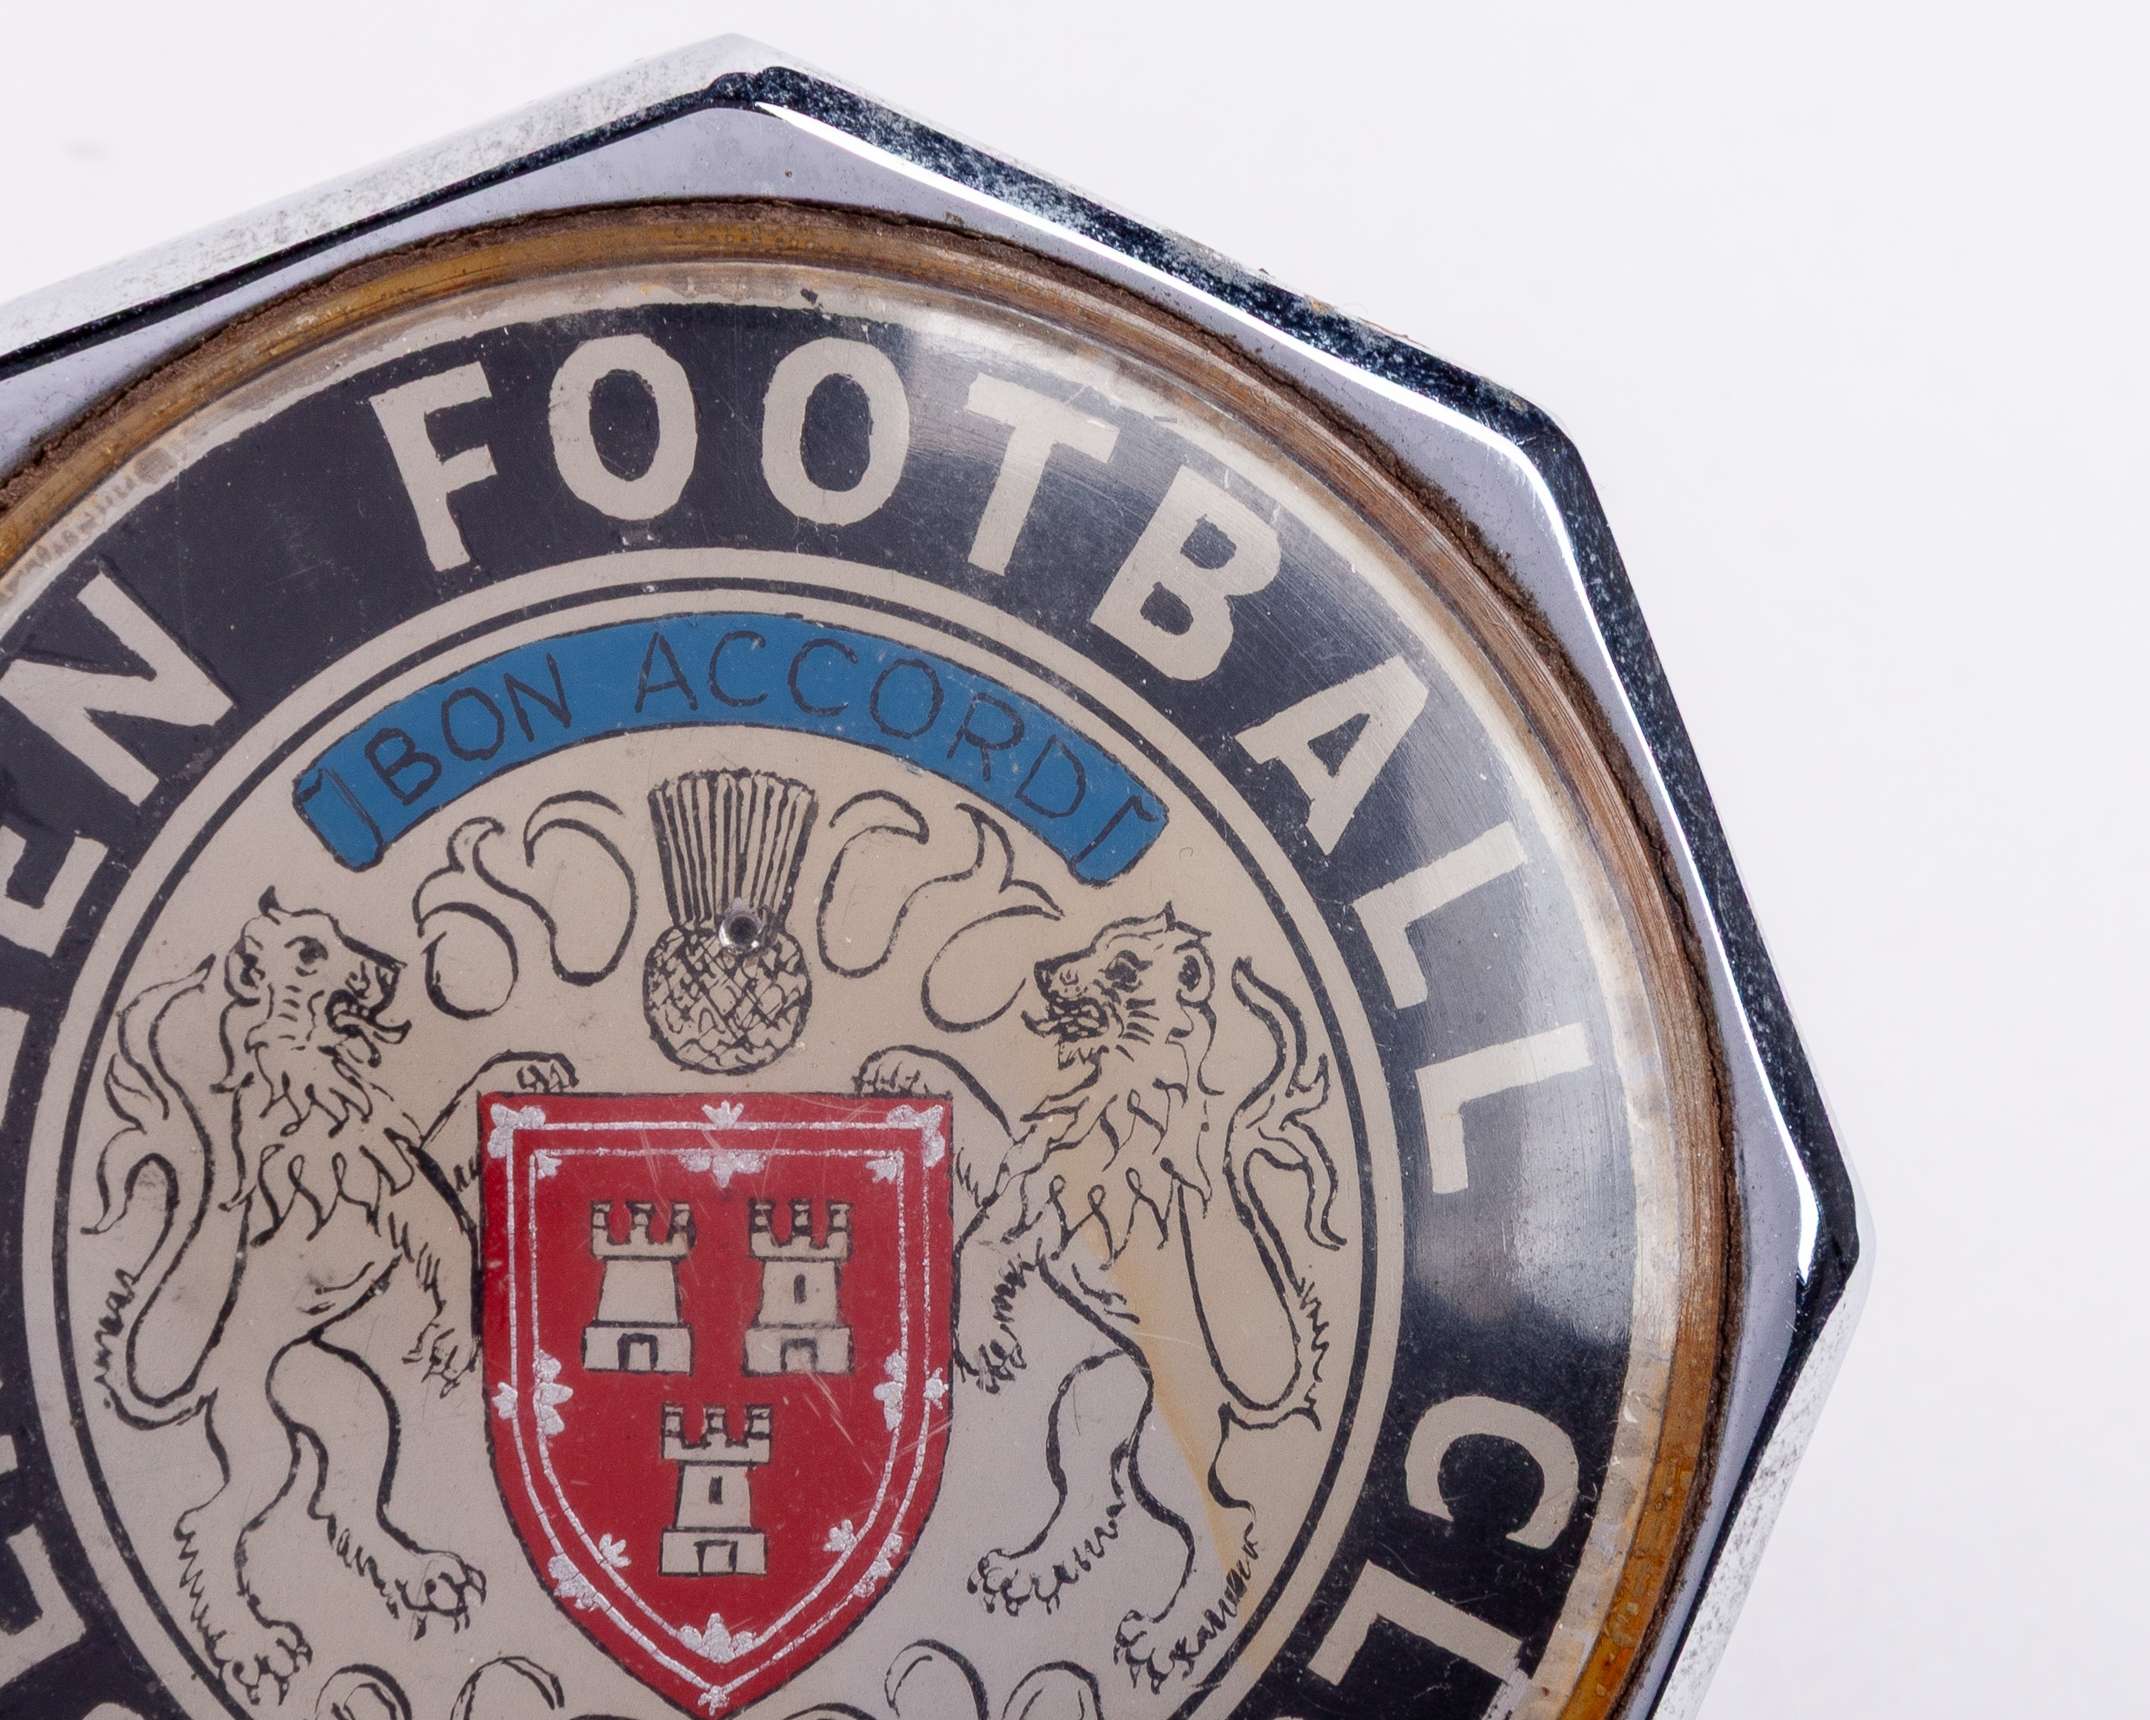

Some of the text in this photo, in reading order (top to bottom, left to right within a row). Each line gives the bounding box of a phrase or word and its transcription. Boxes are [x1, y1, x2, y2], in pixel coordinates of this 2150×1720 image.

[367, 630, 1087, 820] BON ACCORD
[371, 333, 1595, 1720] FOOTBALL CL
